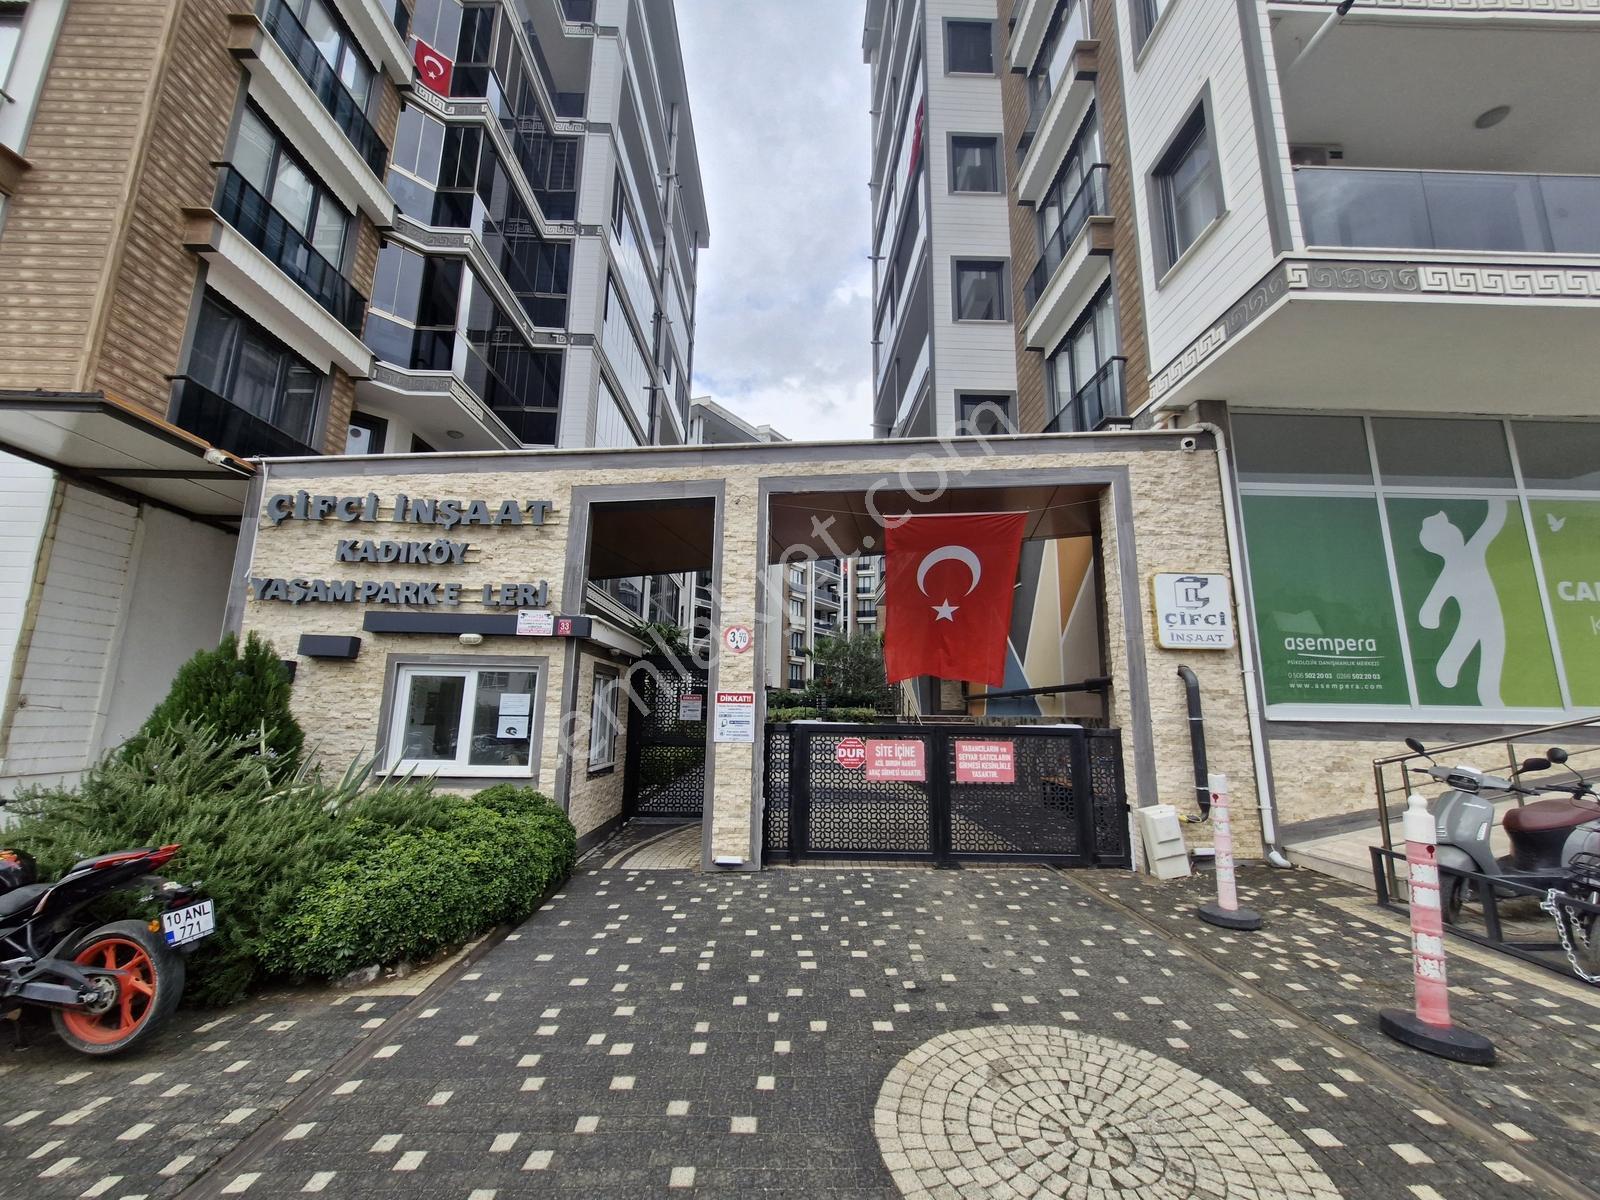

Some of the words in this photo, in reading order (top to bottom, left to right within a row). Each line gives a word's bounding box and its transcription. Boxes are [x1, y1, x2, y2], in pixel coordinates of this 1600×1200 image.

[266, 490, 379, 525] ÇİFCİ
[392, 493, 552, 530] İNŞAAT
[335, 538, 470, 566] KADIKÖY
[1557, 581, 1600, 601] CA
[560, 622, 570, 631] 33
[1165, 611, 1227, 628] ÇİFCİ
[1284, 637, 1377, 655] asempera
[838, 748, 865, 758] DUR
[875, 743, 893, 757] SİTE
[894, 743, 916, 759] İÇİNE
[167, 912, 181, 927] 10
[185, 904, 211, 922] ANL
[179, 920, 201, 938] 771
